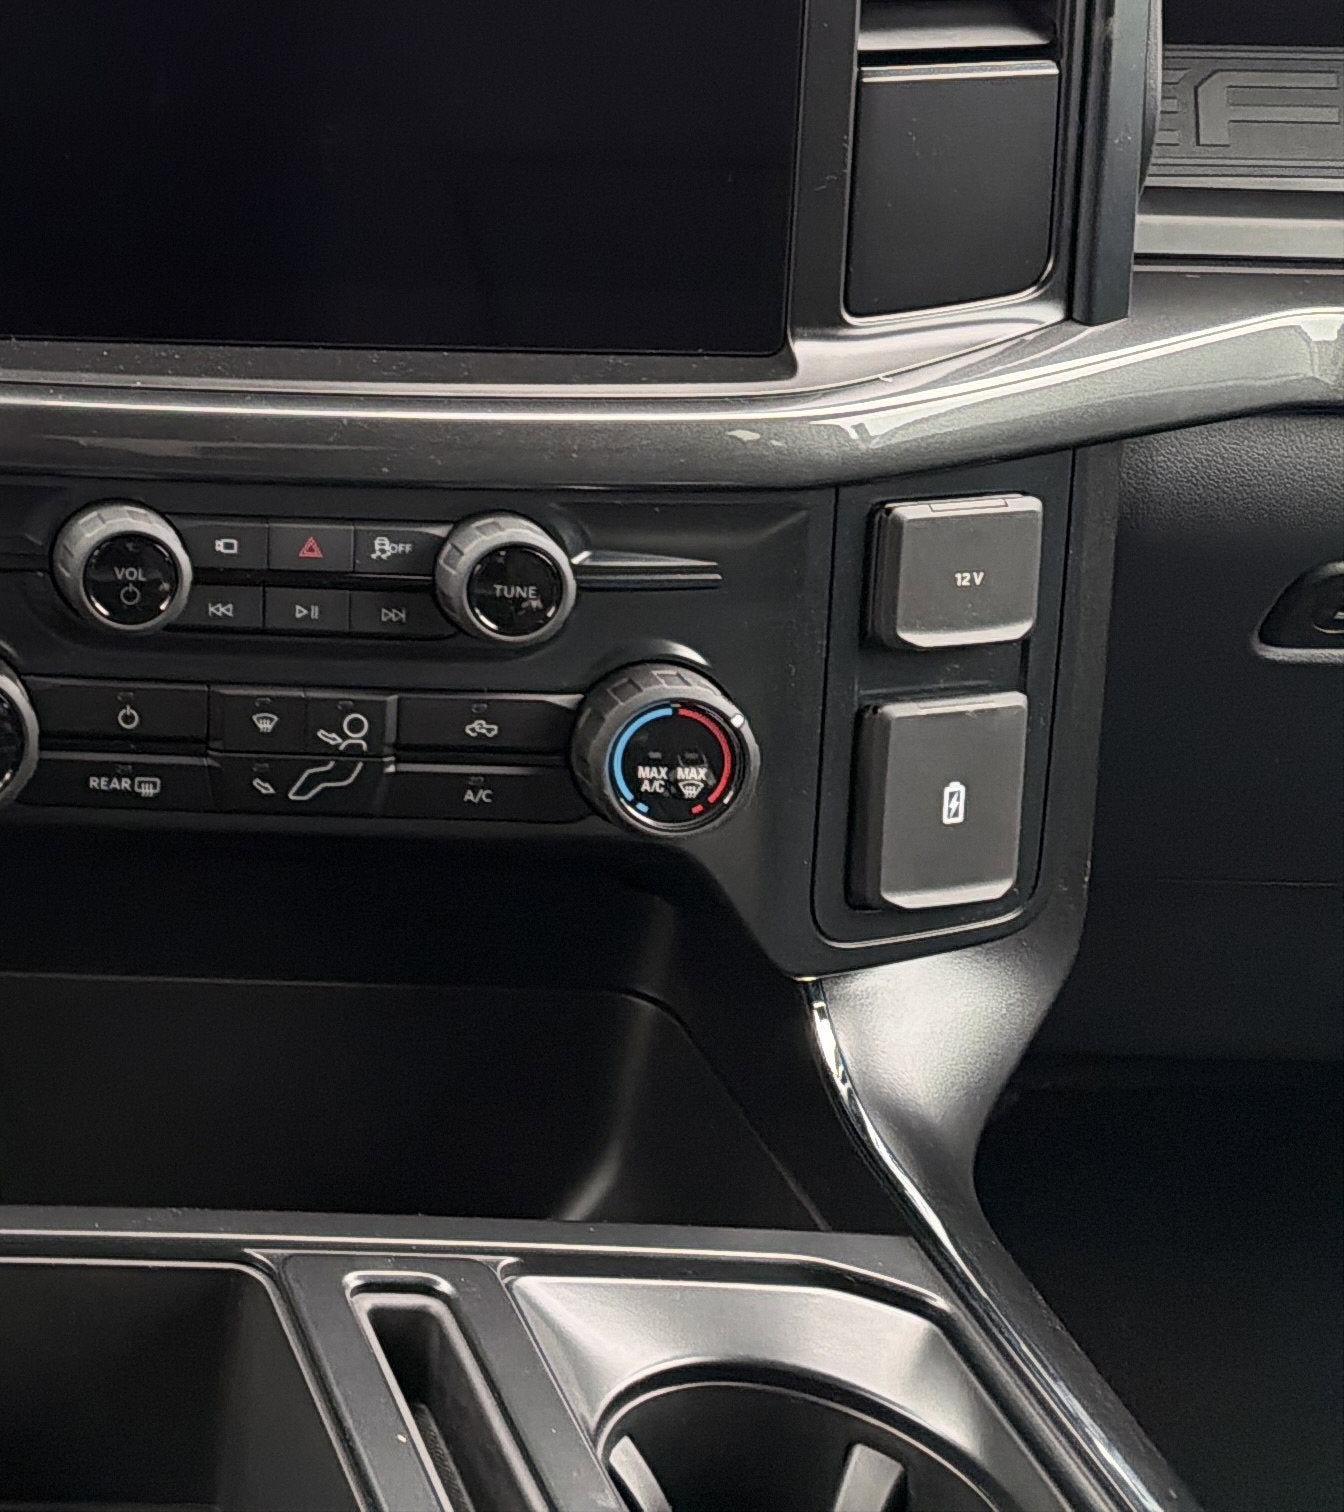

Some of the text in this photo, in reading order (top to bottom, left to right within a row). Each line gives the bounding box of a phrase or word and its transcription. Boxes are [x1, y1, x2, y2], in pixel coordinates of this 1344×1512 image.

[388, 542, 413, 556] OFF
[114, 567, 148, 582] VOL
[493, 584, 538, 600] TUNE
[637, 766, 668, 781] MAX
[676, 767, 708, 782] MAX
[88, 776, 132, 792] REAR
[640, 779, 666, 794] A/C
[463, 788, 494, 805] A/C
